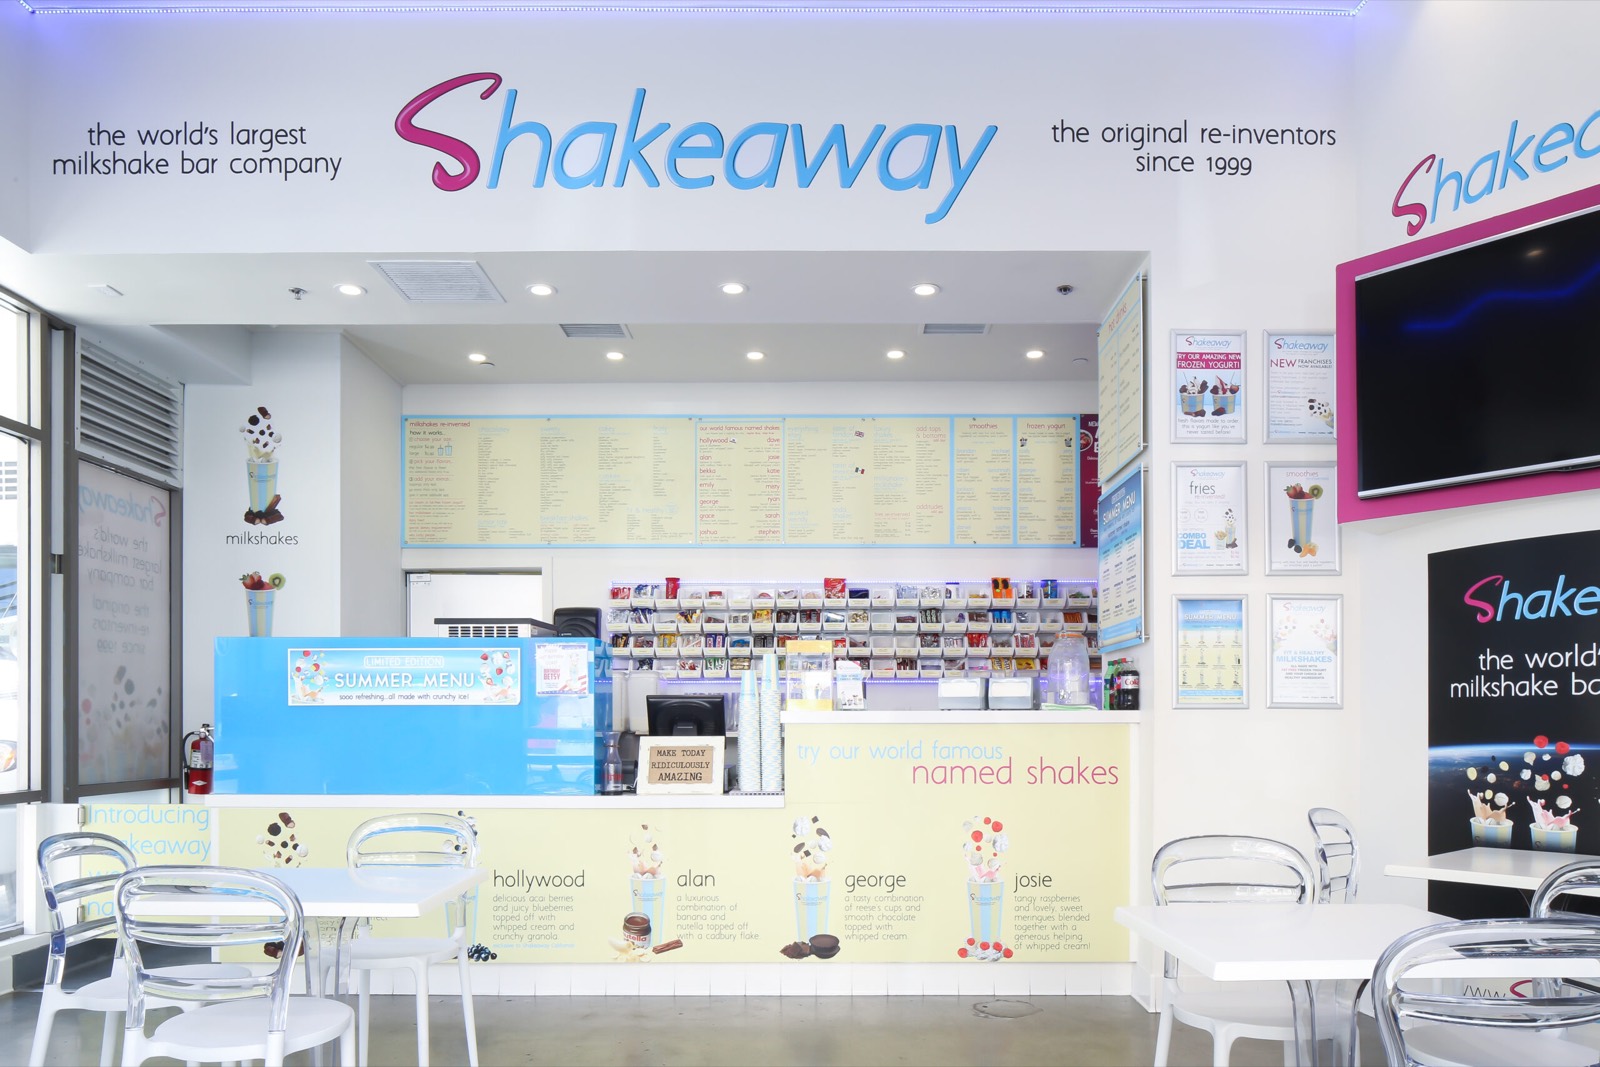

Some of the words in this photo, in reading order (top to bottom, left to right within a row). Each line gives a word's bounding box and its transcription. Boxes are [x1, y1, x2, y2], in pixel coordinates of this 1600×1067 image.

[87, 122, 125, 147] the
[137, 121, 218, 147] world's
[230, 121, 306, 152] largest
[1052, 119, 1089, 143] the
[1102, 120, 1187, 150] original
[1200, 124, 1336, 146] re-inventors
[395, 72, 998, 224] Shakeaway
[53, 151, 169, 175] milkshake
[181, 151, 218, 175] bar
[230, 152, 342, 181] company
[1135, 151, 1195, 173] since
[1207, 156, 1252, 176] 1999
[1185, 335, 1232, 349] Shakeaway
[1274, 337, 1329, 353] Shakeaway
[1177, 361, 1206, 369] FROZEN
[1270, 358, 1297, 368] NEW
[968, 422, 998, 430] smoothies
[1047, 423, 1066, 431] yogurt
[1285, 470, 1319, 478] smoothies
[1189, 480, 1216, 495] fries
[226, 531, 299, 546] milkshakes
[1464, 575, 1600, 623] Shake
[366, 657, 401, 666] LIMITED
[404, 657, 441, 666] EDITION
[1276, 655, 1333, 663] MILKSHAKES
[1478, 648, 1514, 671] the
[334, 672, 413, 688] SUMMER
[423, 672, 475, 688] MENU
[1450, 672, 1558, 698] milkshake
[432, 693, 456, 702] crunchy
[656, 749, 677, 757] MAKE
[681, 749, 706, 757] TODAY
[797, 743, 820, 765] try
[829, 745, 860, 760] our
[868, 740, 923, 760] world
[932, 740, 1003, 760] famous
[651, 761, 711, 769] RIDICULOUSLY
[912, 756, 1012, 785] named
[1026, 756, 1119, 785] shakes
[657, 772, 703, 781] AMAZING
[88, 804, 210, 831] Introducing
[125, 833, 212, 862] keaway
[493, 869, 585, 893] hollywood
[676, 868, 716, 888] alan
[1013, 872, 1053, 893] josie
[844, 874, 907, 893] george
[492, 894, 526, 902] delicious
[548, 894, 574, 902] berries
[685, 893, 720, 902] luxurious
[853, 895, 871, 904] tasty
[874, 894, 925, 902] combination
[1014, 895, 1037, 904] tangy
[1040, 894, 1081, 904] raspberries
[492, 904, 509, 912] and
[511, 904, 529, 913] juicy
[532, 904, 574, 912] blueberries
[676, 903, 727, 912] combination
[729, 903, 738, 912] of
[844, 903, 853, 911] of
[883, 904, 902, 913] cups
[905, 903, 921, 911] and
[492, 914, 521, 923] topped
[523, 913, 535, 921] off
[676, 912, 707, 921] banana
[710, 912, 726, 921] and
[844, 913, 874, 921] smooth
[877, 912, 917, 921] chocolate
[1014, 914, 1055, 923] meringues
[1058, 913, 1090, 921] blended
[492, 923, 528, 932] whipped
[558, 923, 575, 931] and
[676, 922, 704, 931] nutella
[706, 922, 735, 932] topped
[737, 922, 749, 931] off
[844, 923, 873, 932] topped
[1014, 923, 1048, 933] together
[1050, 923, 1068, 931] with
[492, 932, 524, 942] crunchy
[676, 932, 694, 940] with
[705, 932, 737, 942] cadbury
[844, 932, 879, 942] whipped
[1014, 933, 1050, 943] generous
[1053, 932, 1083, 942] helping
[1014, 942, 1022, 950] of
[1025, 942, 1060, 952] whipped
[1063, 942, 1091, 950] cream!
